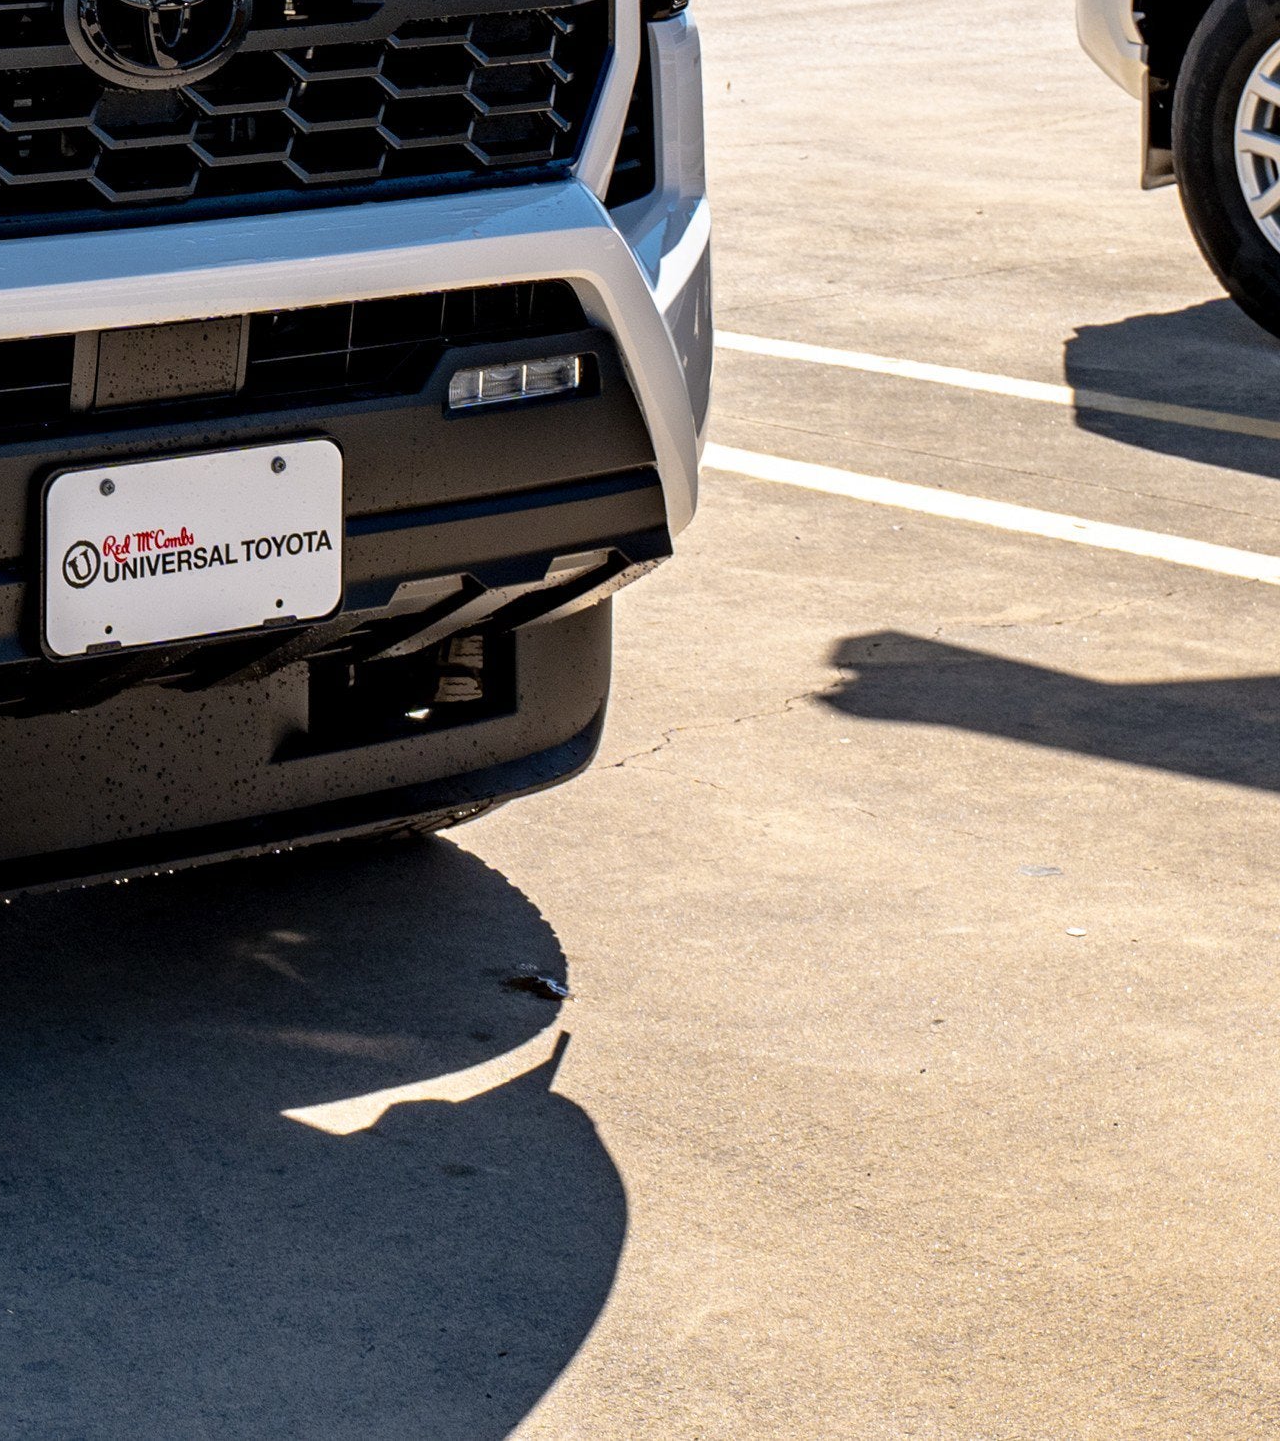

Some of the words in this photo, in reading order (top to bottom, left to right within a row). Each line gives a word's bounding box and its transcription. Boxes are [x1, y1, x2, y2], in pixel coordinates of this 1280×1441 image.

[103, 535, 130, 563] Red
[133, 526, 194, 552] McCombs
[103, 543, 238, 583] UNIVERSAL
[241, 530, 333, 562] TOYOTA
